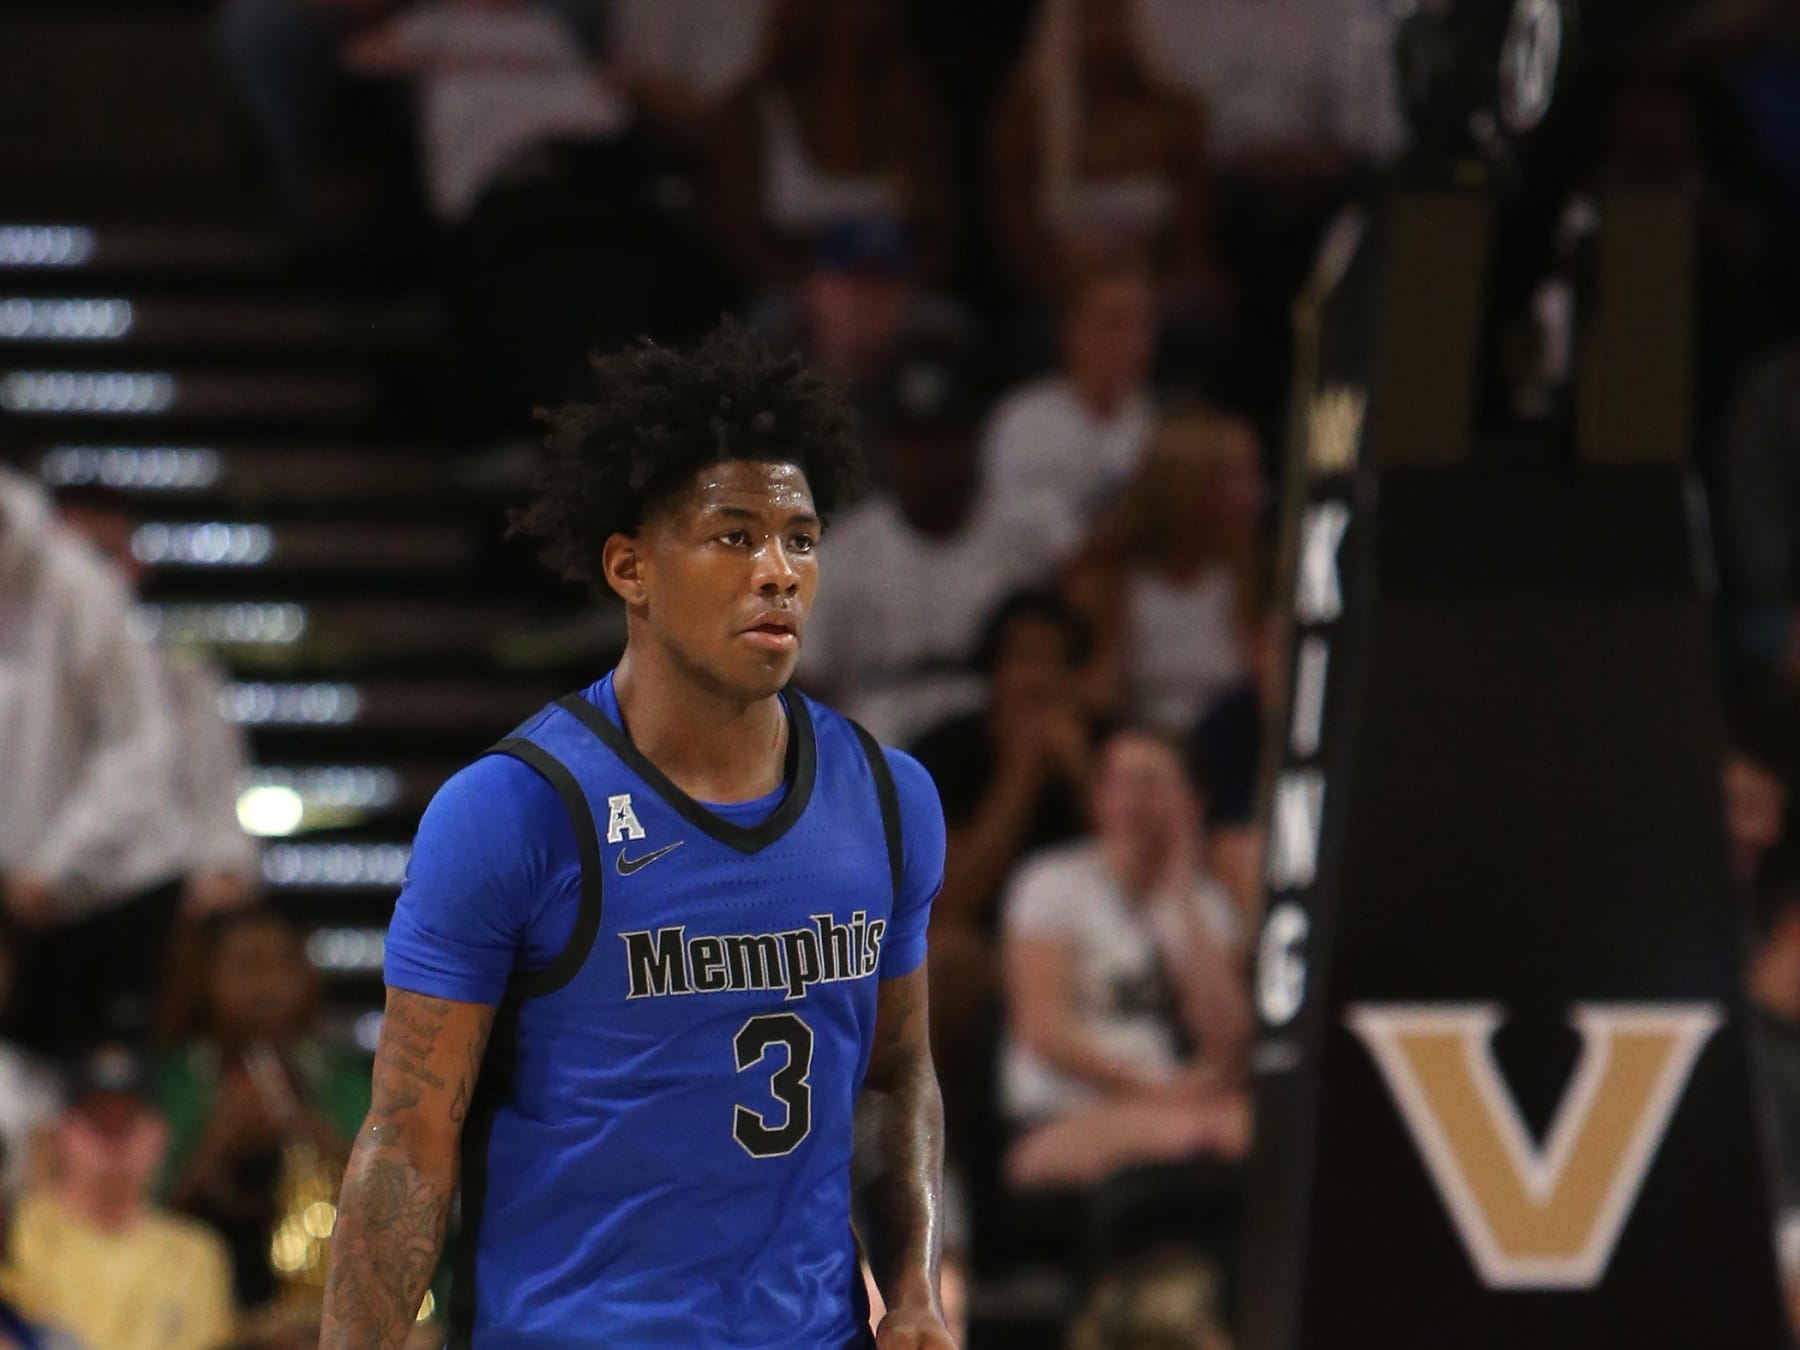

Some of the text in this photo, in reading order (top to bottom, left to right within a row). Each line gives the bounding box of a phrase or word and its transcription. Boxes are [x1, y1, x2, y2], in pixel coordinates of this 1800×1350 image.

[607, 794, 645, 843] A
[618, 910, 886, 1000] Memphis
[733, 1013, 814, 1158] 3
[1345, 1003, 1722, 1287] V
